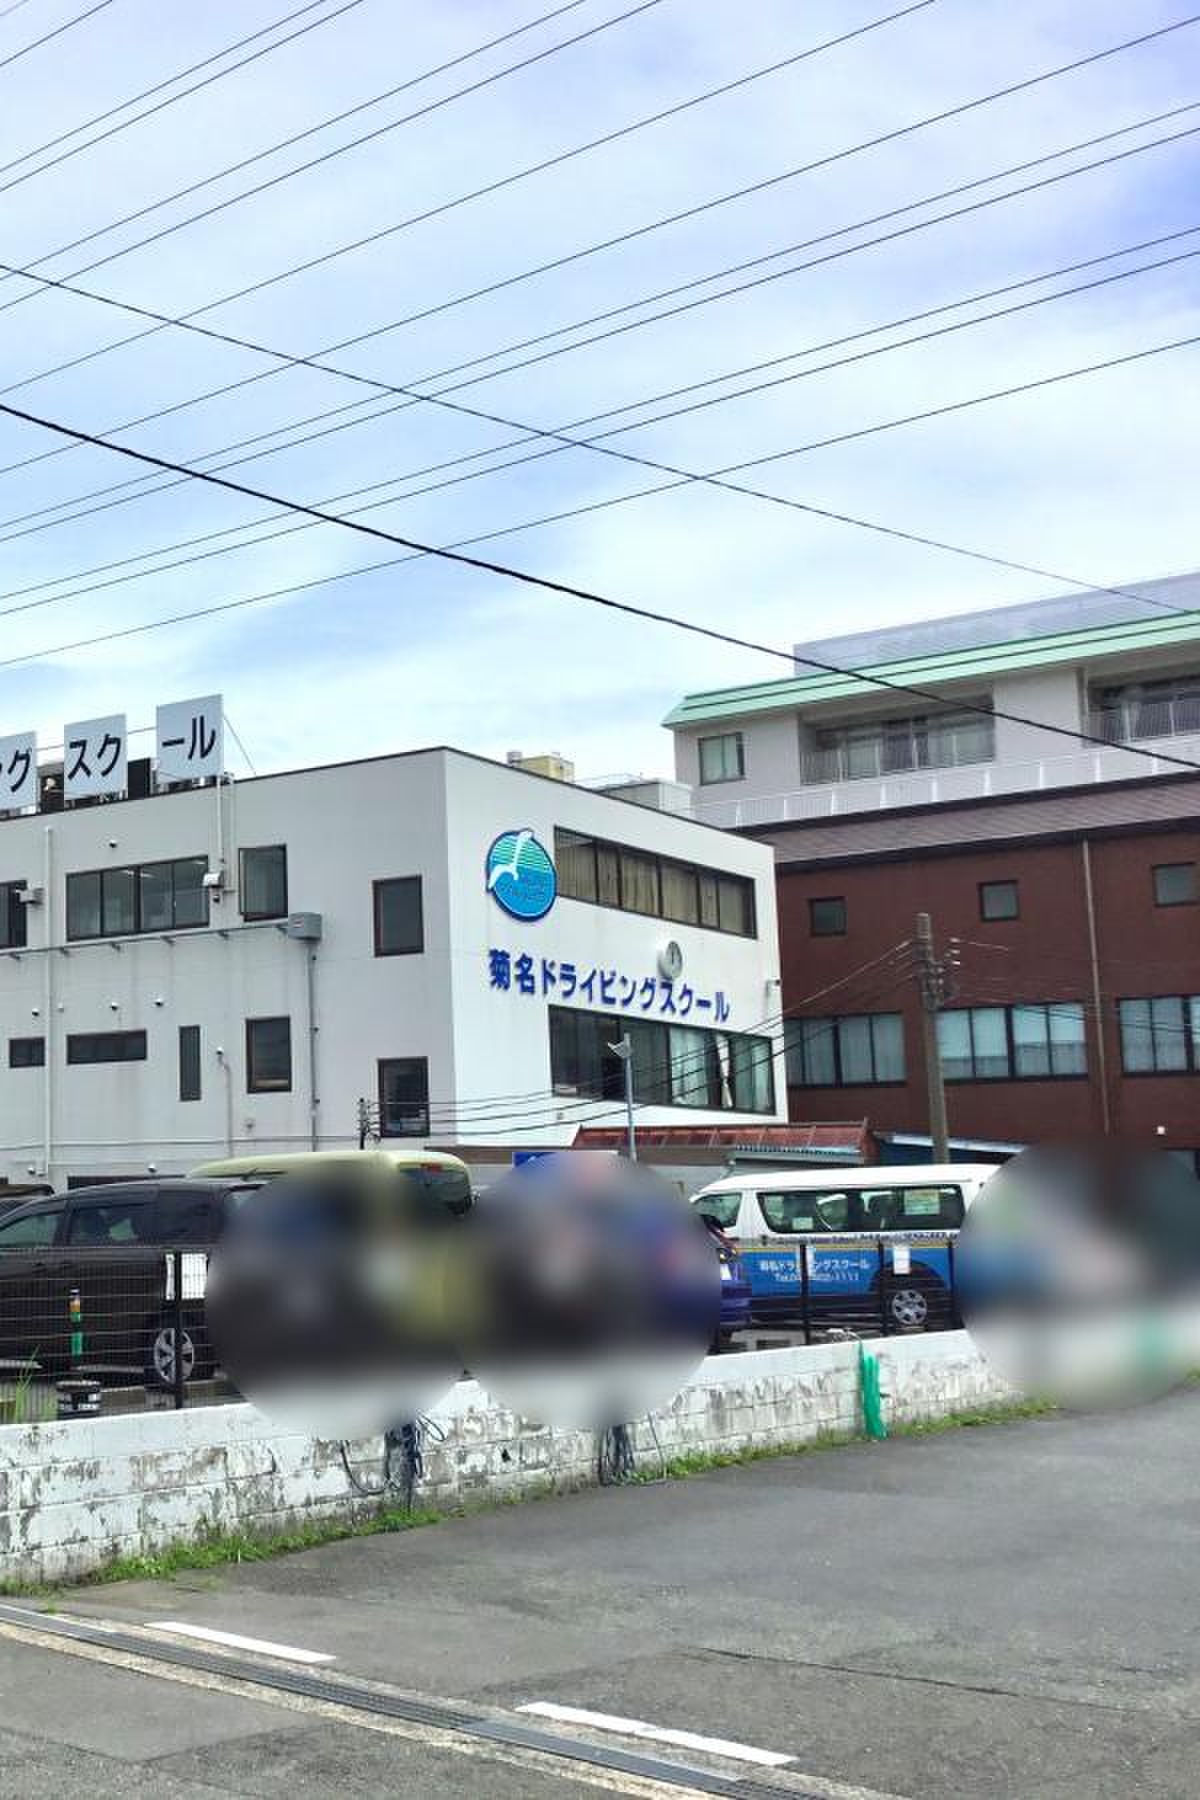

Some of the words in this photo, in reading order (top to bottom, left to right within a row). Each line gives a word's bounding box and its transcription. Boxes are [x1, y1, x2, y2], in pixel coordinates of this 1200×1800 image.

[488, 948, 730, 1022] 菊名ドライビングスクール
